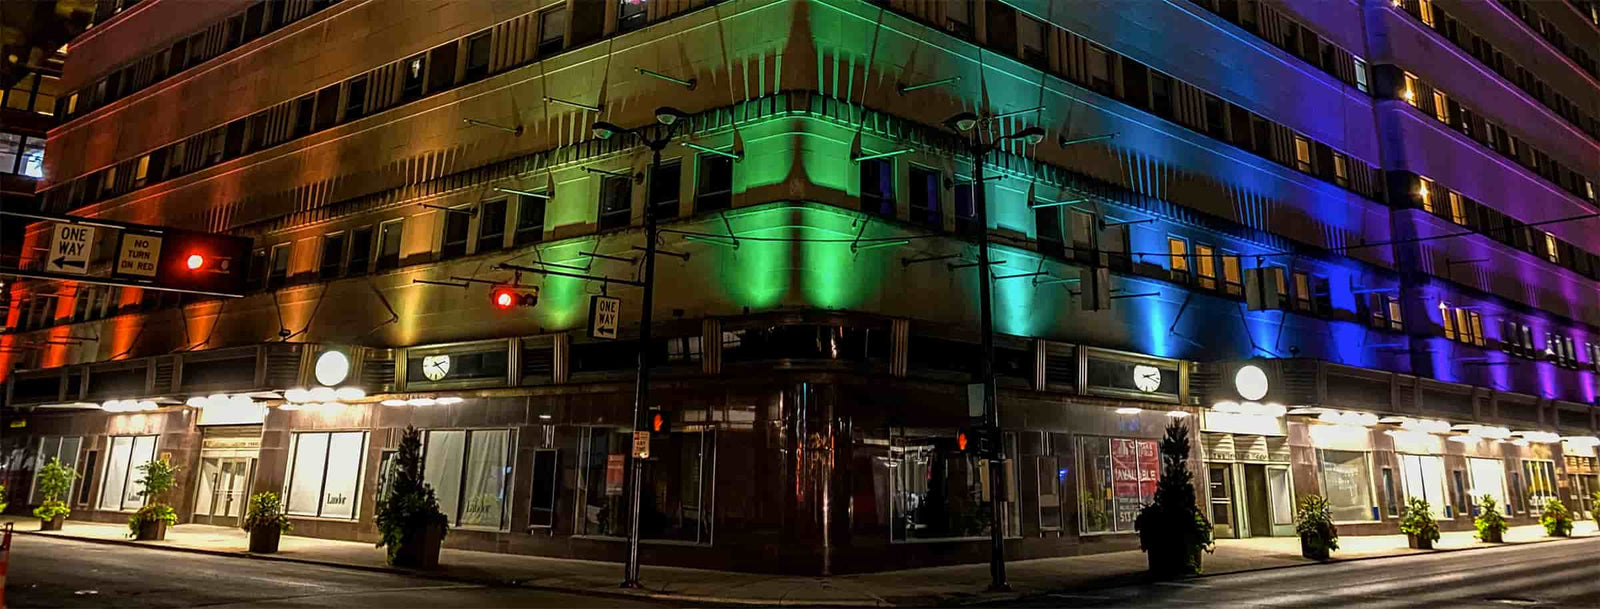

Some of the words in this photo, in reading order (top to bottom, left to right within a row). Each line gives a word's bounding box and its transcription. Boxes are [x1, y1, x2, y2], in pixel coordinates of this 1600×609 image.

[61, 226, 88, 242] ONE
[59, 241, 85, 256] WAY
[134, 239, 149, 248] NO
[128, 249, 150, 259] TURN
[121, 260, 133, 269] ON
[136, 261, 154, 271] RED
[599, 300, 616, 313] ONE
[599, 313, 615, 325] WAY
[1116, 468, 1156, 481] AVAILBLE
